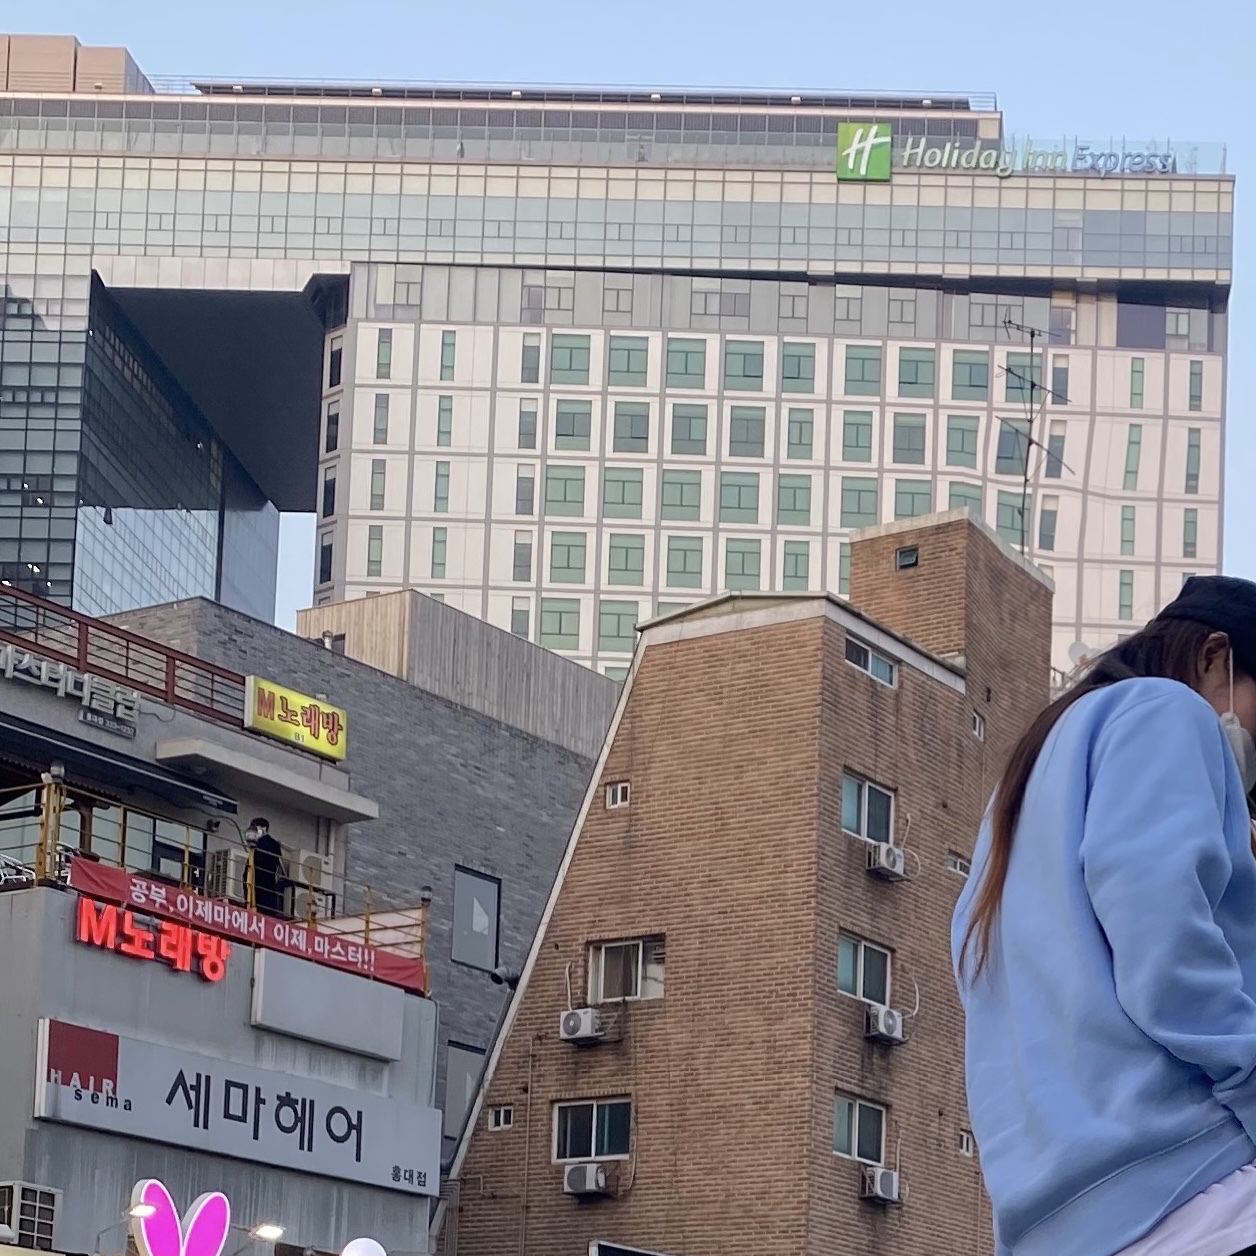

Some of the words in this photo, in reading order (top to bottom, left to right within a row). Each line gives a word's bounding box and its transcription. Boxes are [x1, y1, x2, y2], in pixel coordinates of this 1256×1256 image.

[902, 137, 1016, 178] Holiday
[1023, 139, 1068, 171] Inn
[1070, 145, 1174, 178] Express
[50, 1067, 115, 1097] HAIR
[74, 1086, 132, 1112] sema
[165, 1069, 363, 1163] 세마헤어
[390, 1165, 428, 1187] 홍대점
